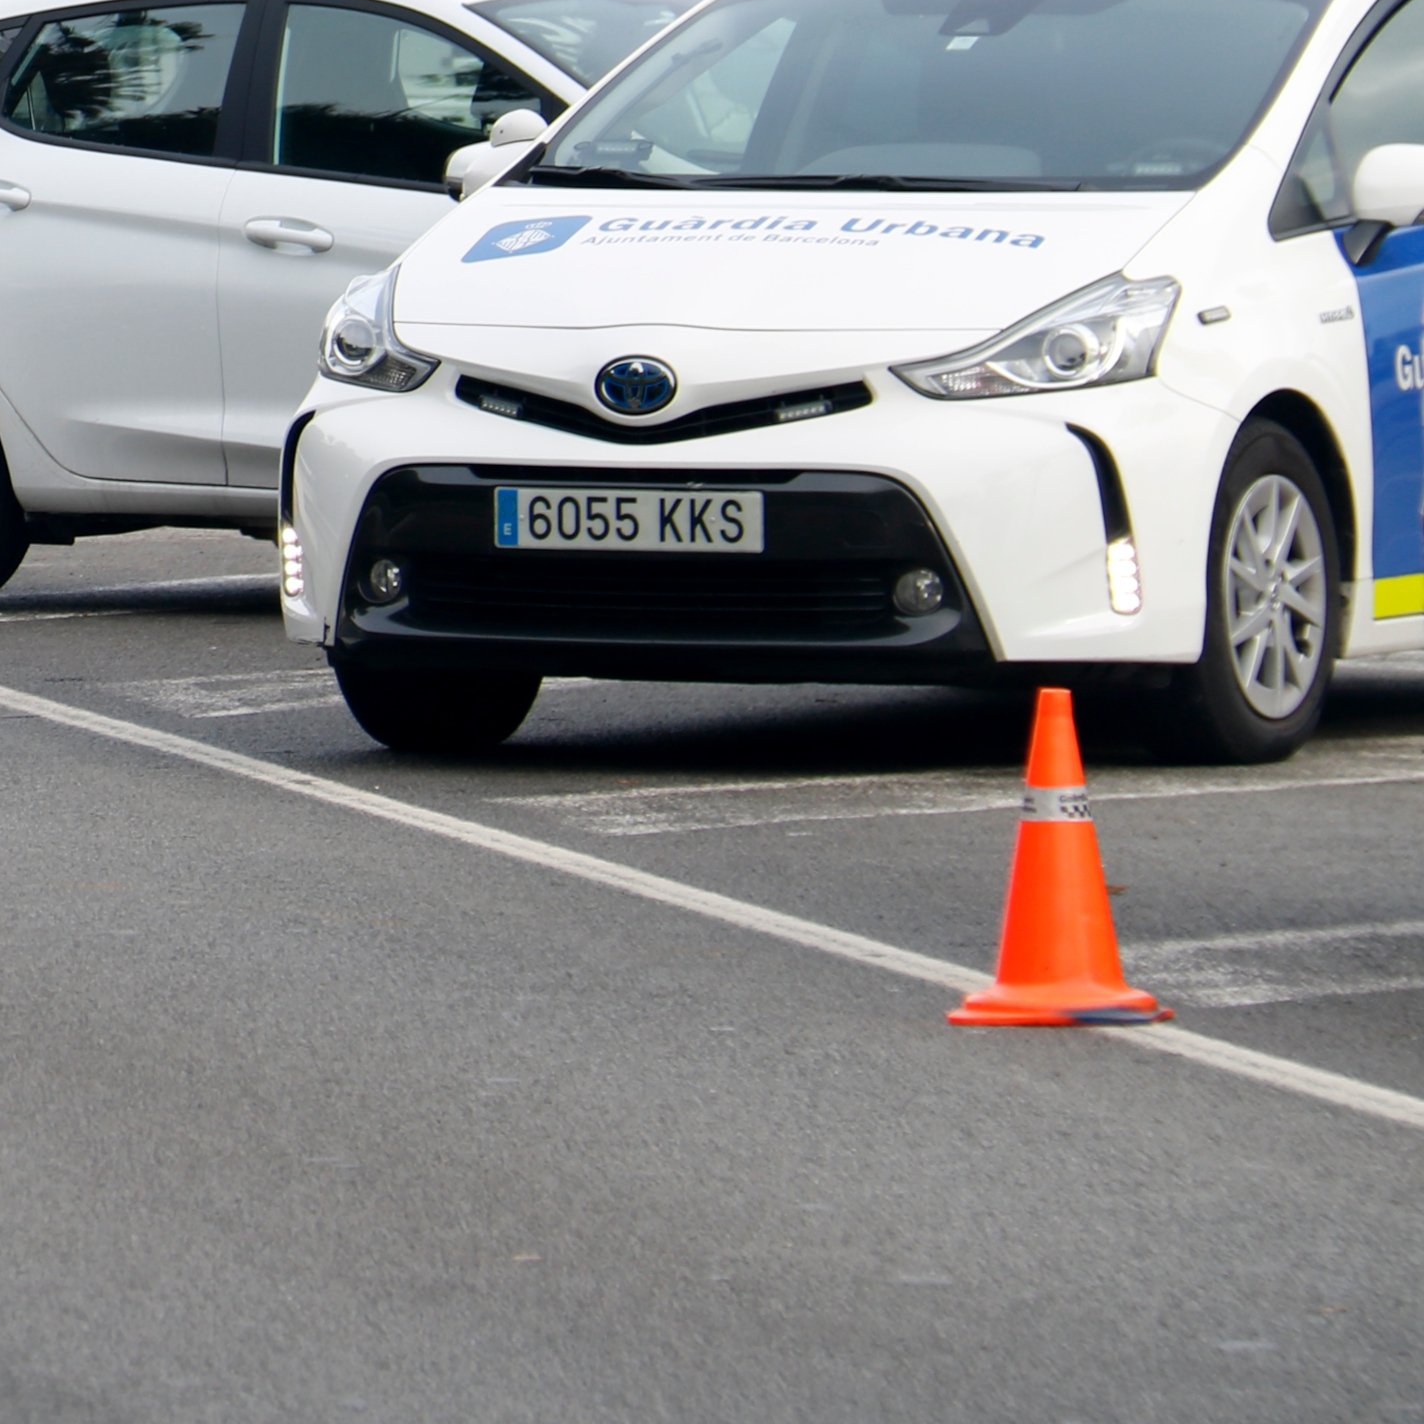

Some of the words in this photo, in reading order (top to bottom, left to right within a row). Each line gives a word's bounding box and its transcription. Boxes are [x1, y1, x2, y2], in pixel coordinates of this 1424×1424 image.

[580, 233, 722, 246] Ajuntament
[727, 233, 757, 242] de
[762, 234, 880, 247] Barcelona
[598, 215, 819, 232] Guàrdia
[840, 217, 1046, 249] Urbana
[528, 495, 640, 541] 6055
[659, 497, 745, 543] KKS
